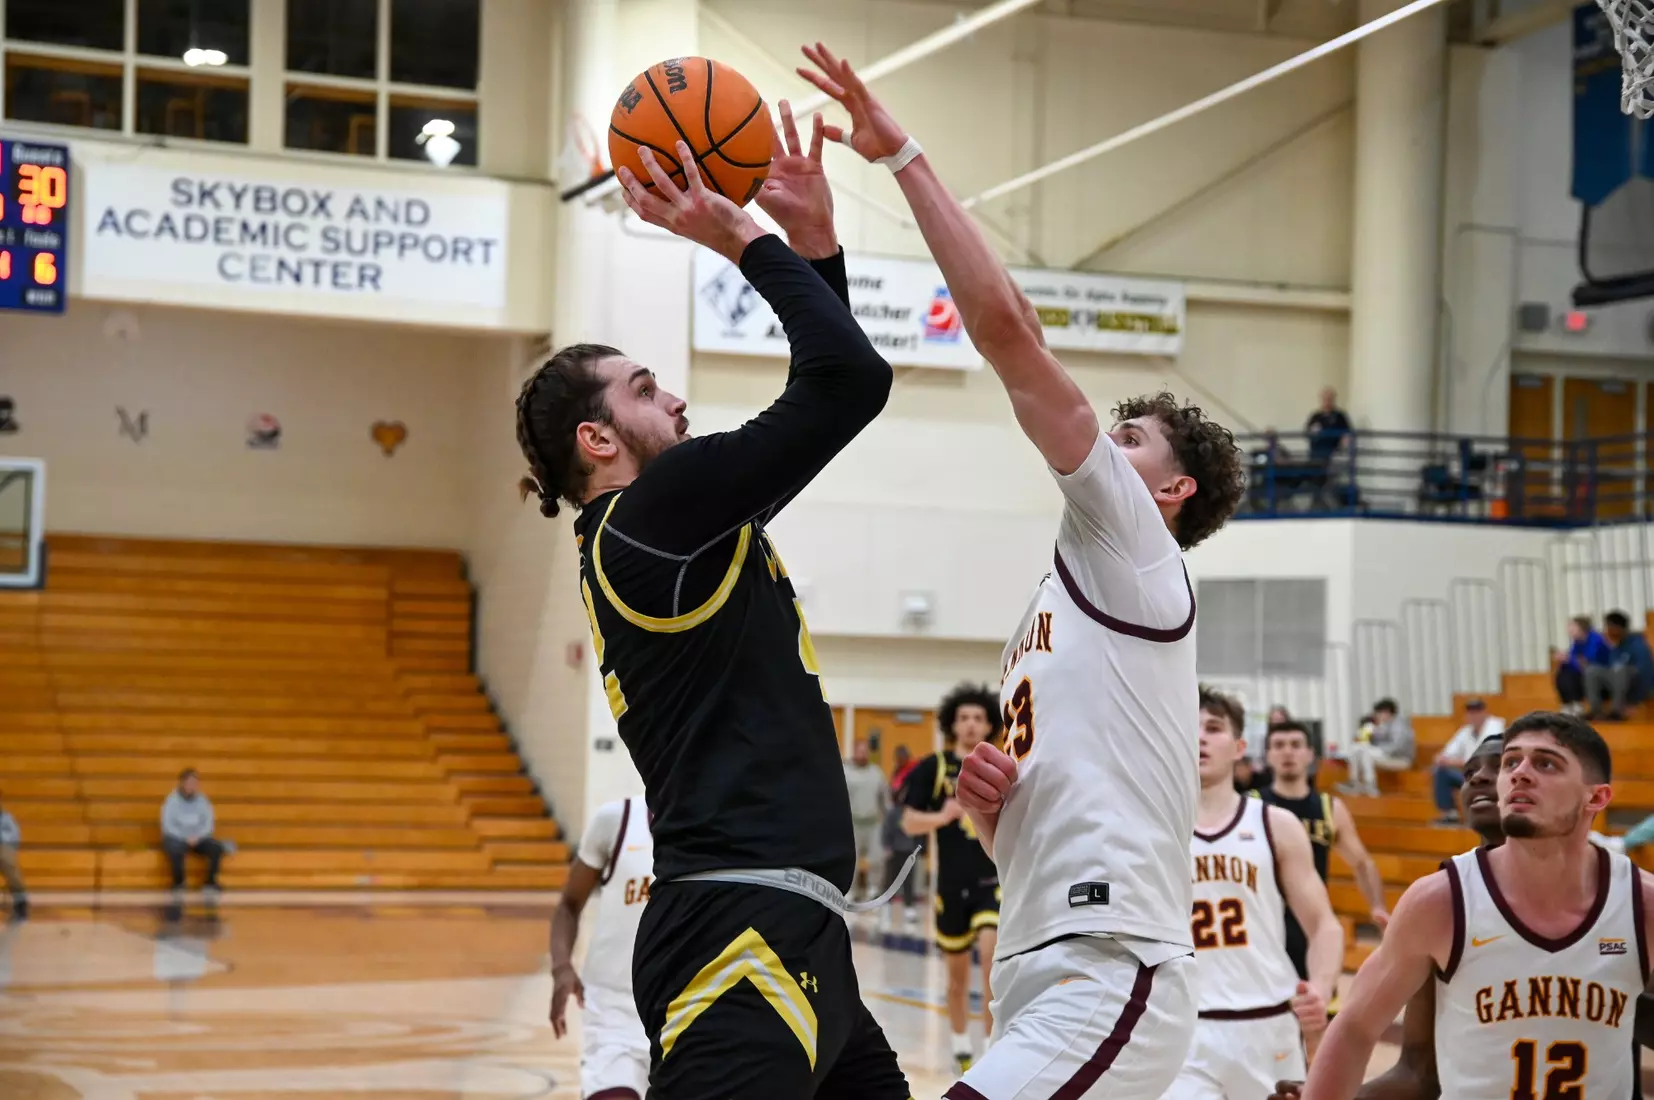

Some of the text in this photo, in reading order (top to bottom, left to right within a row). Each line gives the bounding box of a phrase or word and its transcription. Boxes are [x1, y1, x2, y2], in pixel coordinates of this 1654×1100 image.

[18, 164, 67, 208] 30
[169, 177, 431, 227] SKYBOX AND
[97, 206, 309, 252] ACADEMIC
[321, 226, 498, 266] SUPPORT
[34, 252, 57, 285] 6
[217, 253, 383, 291] CENTER
[1094, 888, 1101, 898] L
[1191, 854, 1258, 894] NNON
[1191, 897, 1249, 950] 22
[1599, 942, 1628, 951] PSAC
[1475, 976, 1628, 1028] GANNON
[1510, 1038, 1588, 1100] 12
